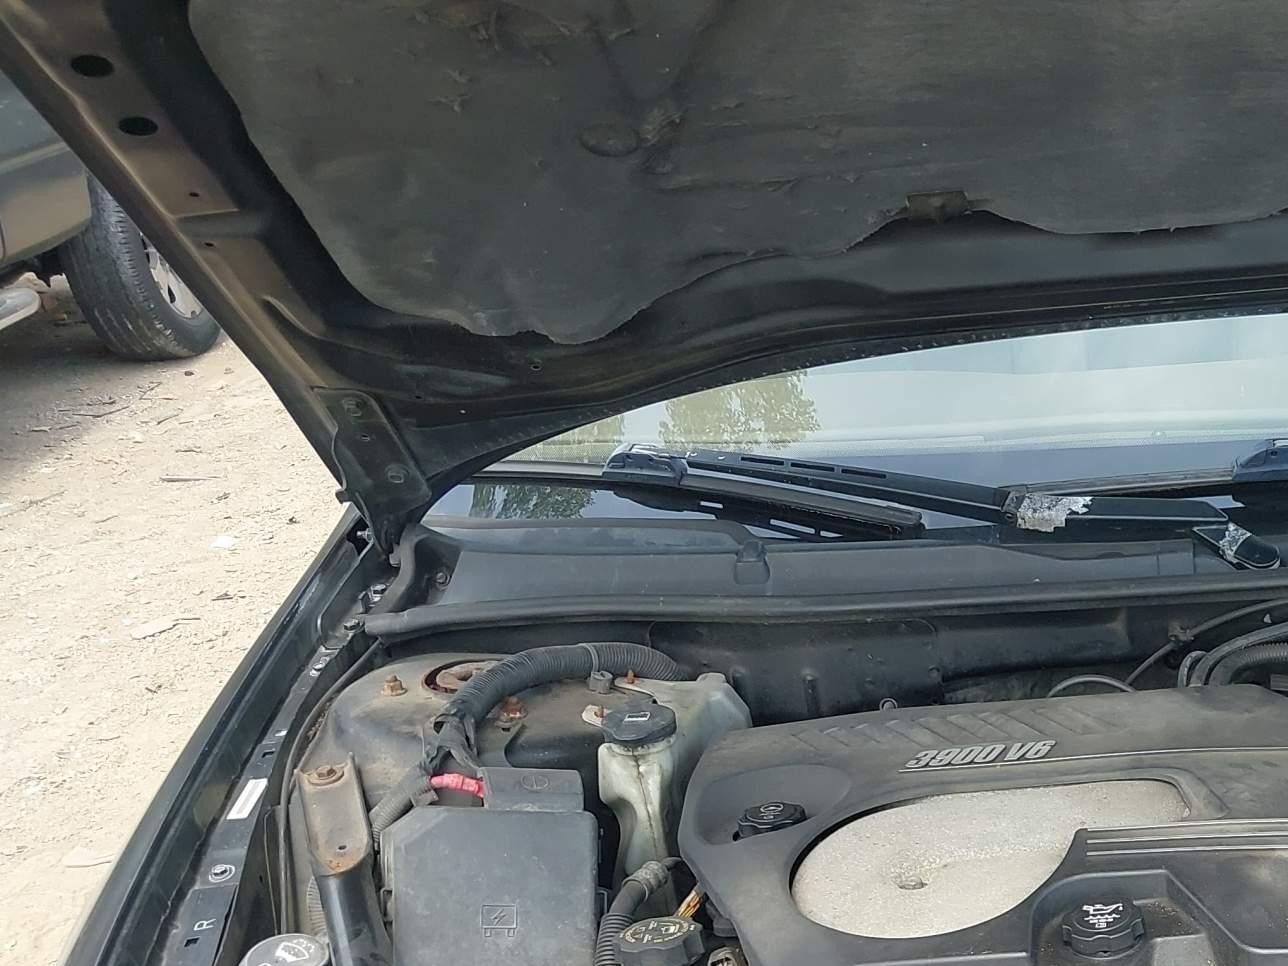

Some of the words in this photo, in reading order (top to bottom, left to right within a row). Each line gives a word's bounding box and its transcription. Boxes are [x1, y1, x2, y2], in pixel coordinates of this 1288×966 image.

[905, 744, 1006, 768] 3900
[1004, 740, 1057, 761] V6
[193, 918, 217, 931] R
